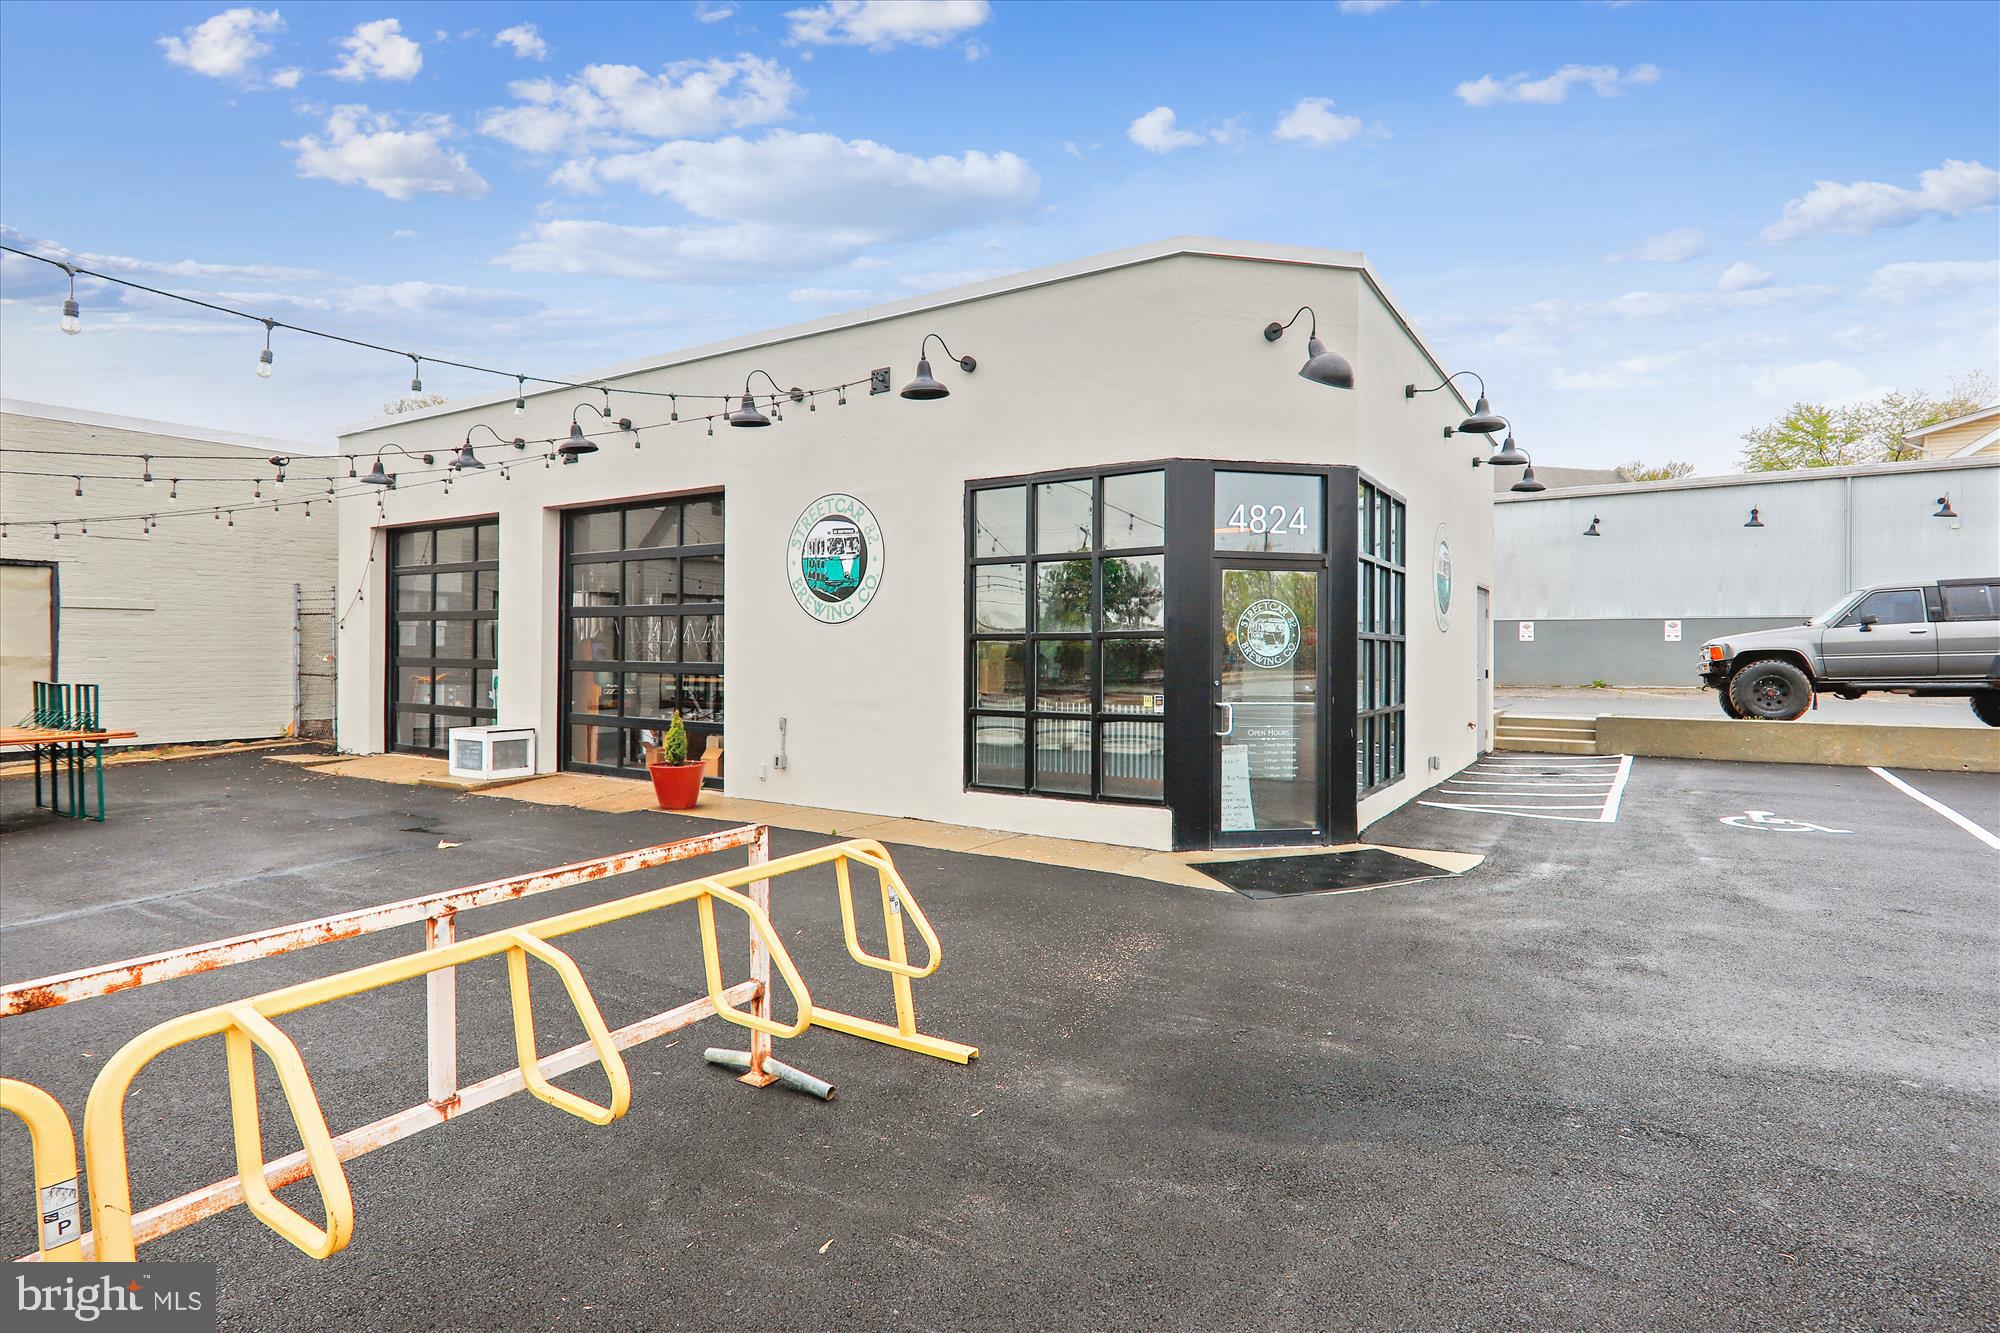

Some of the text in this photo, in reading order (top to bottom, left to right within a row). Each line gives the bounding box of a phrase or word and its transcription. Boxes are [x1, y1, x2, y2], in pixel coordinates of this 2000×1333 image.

[791, 498, 880, 551] STREETCAR 82
[1228, 503, 1308, 535] 4824
[792, 574, 880, 621] BREWING CO.
[1240, 602, 1297, 629] STREETCAR 82
[1241, 641, 1297, 666] BREWING CO.
[58, 1220, 71, 1235] P
